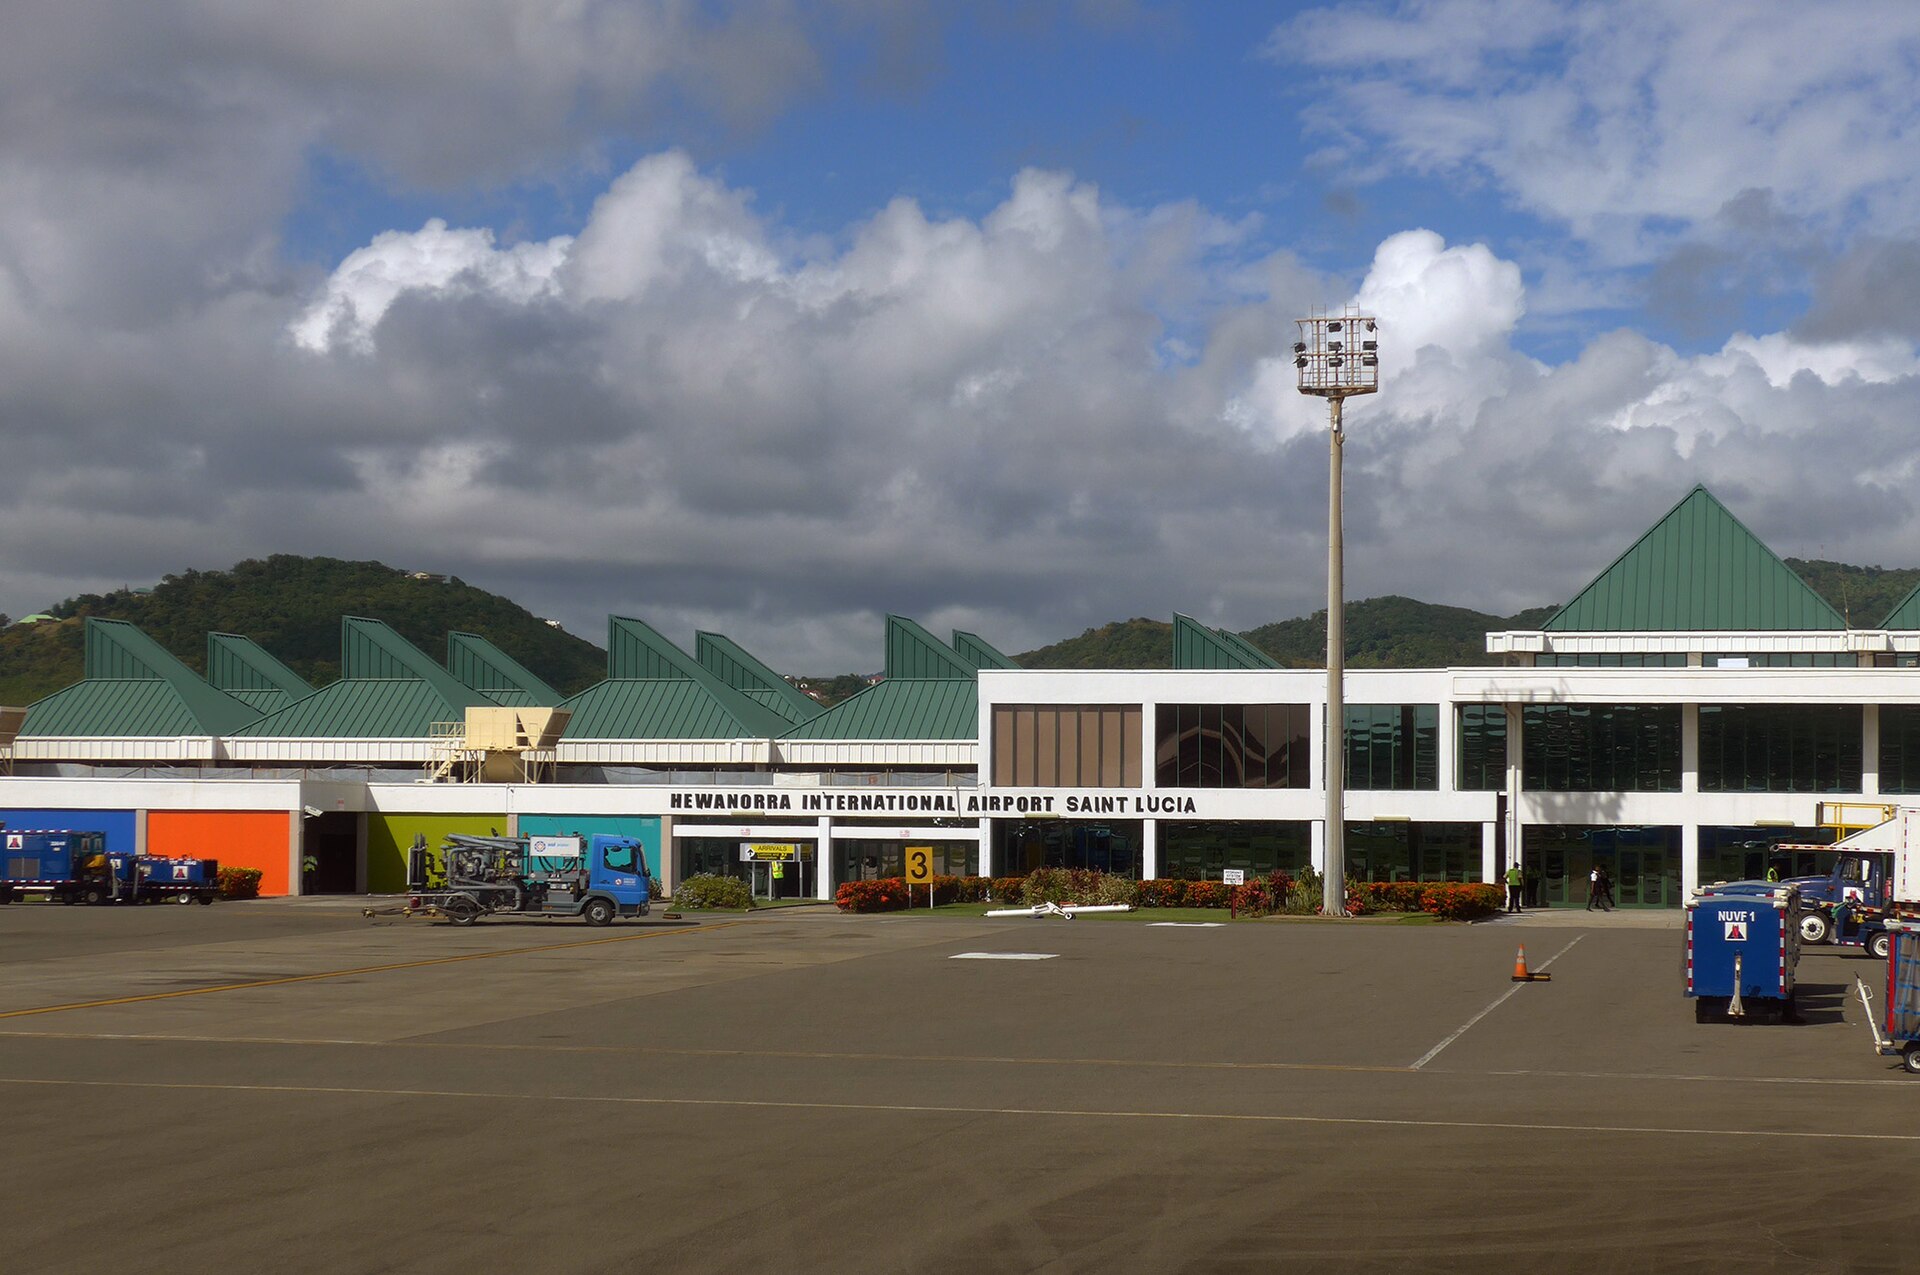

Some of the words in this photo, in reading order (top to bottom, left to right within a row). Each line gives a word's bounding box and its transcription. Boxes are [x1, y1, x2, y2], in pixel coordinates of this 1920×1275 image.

[670, 793, 791, 810] HEWANORRA
[802, 794, 955, 811] INTERNATIONAL
[967, 796, 1054, 812] AIRPORT
[1066, 796, 1128, 813] SAINT
[1135, 796, 1196, 813] LUCIA
[911, 851, 927, 879] 3
[1718, 911, 1748, 922] NUVF
[1749, 911, 1755, 922] 1
